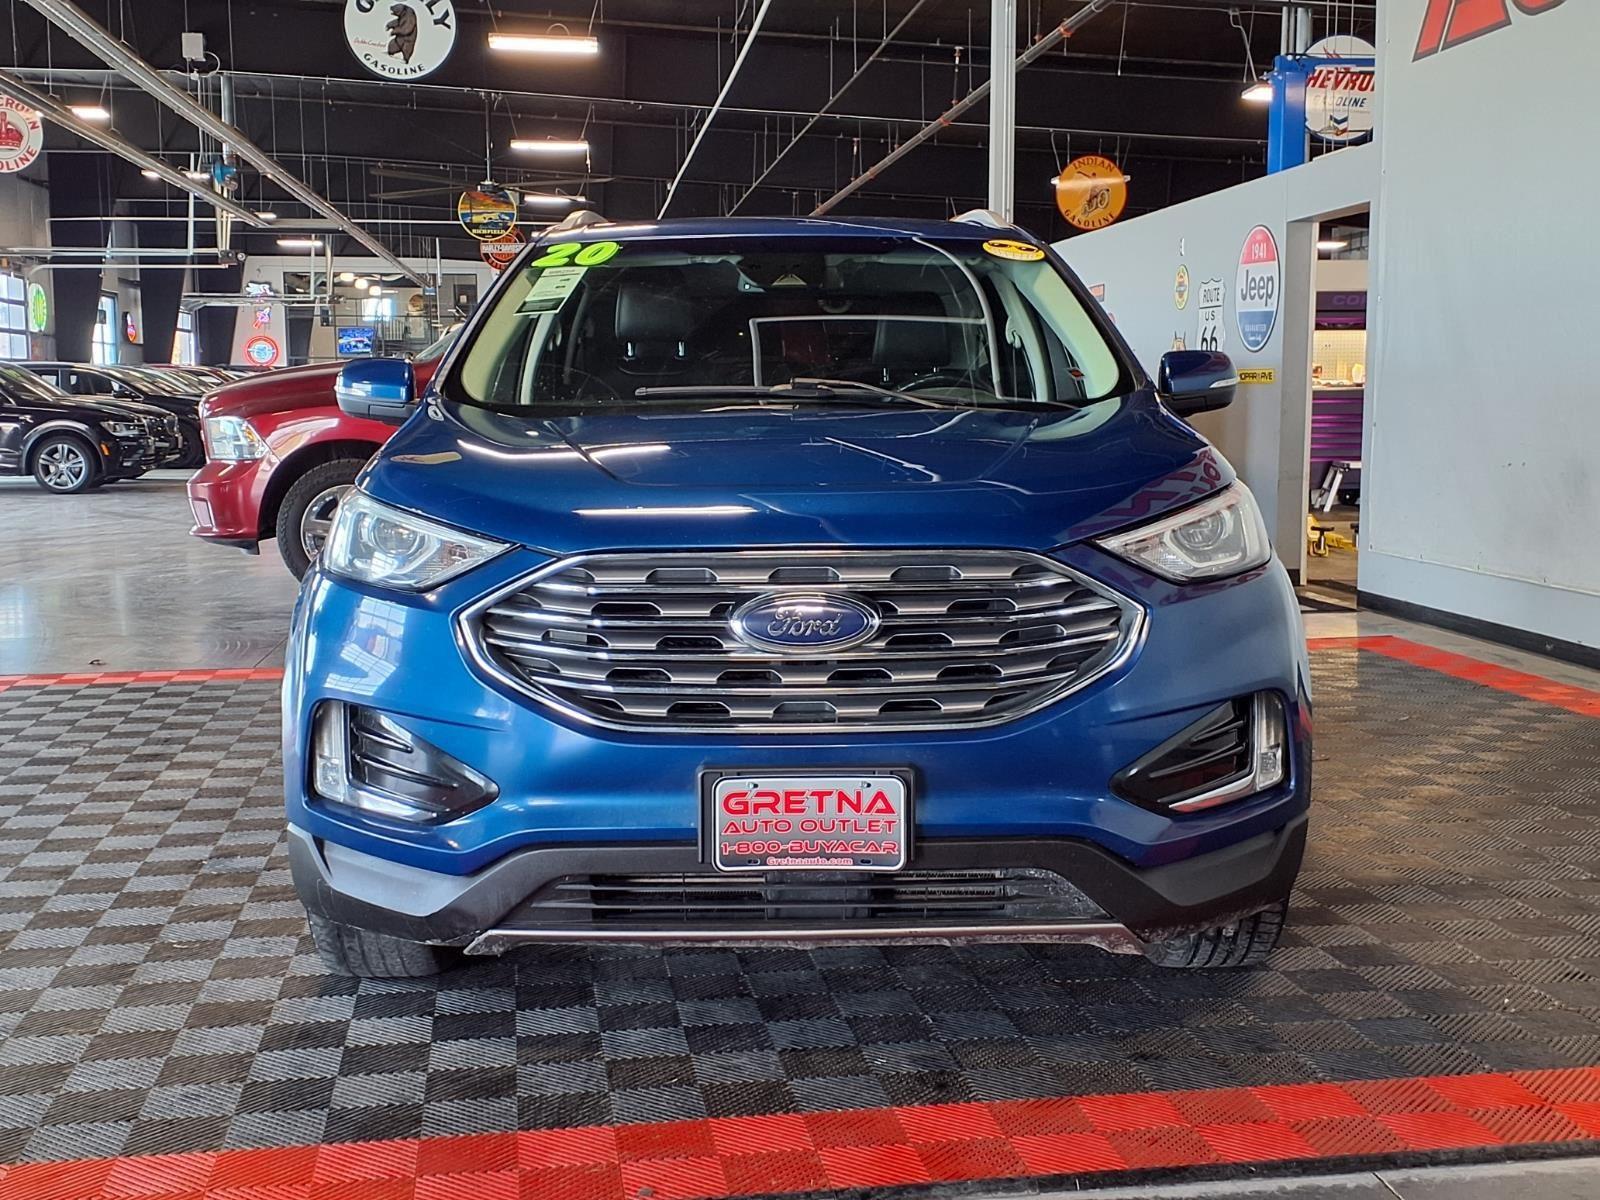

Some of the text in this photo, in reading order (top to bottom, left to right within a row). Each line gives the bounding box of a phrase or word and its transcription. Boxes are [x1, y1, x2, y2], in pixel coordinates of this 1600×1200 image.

[363, 53, 426, 75] GASOLINE
[1306, 68, 1375, 92] HEVRO
[1313, 94, 1367, 108] OLINE
[1073, 157, 1115, 173] INDIAN
[1064, 209, 1114, 227] GASOLINE
[531, 241, 620, 267] 20
[1251, 242, 1267, 259] 1941
[1203, 287, 1220, 303] ROUTE
[1240, 269, 1275, 308] Jeep
[1204, 310, 1216, 321] US
[1200, 326, 1218, 351] 66
[1239, 371, 1273, 380] OPAR AVE
[767, 606, 843, 637] Ford
[722, 790, 897, 815] GRETNA
[721, 818, 899, 835] AUTO OUTLET
[721, 840, 898, 855] 1-800-BUYACAR
[766, 856, 853, 866] Gretnaauto.com
